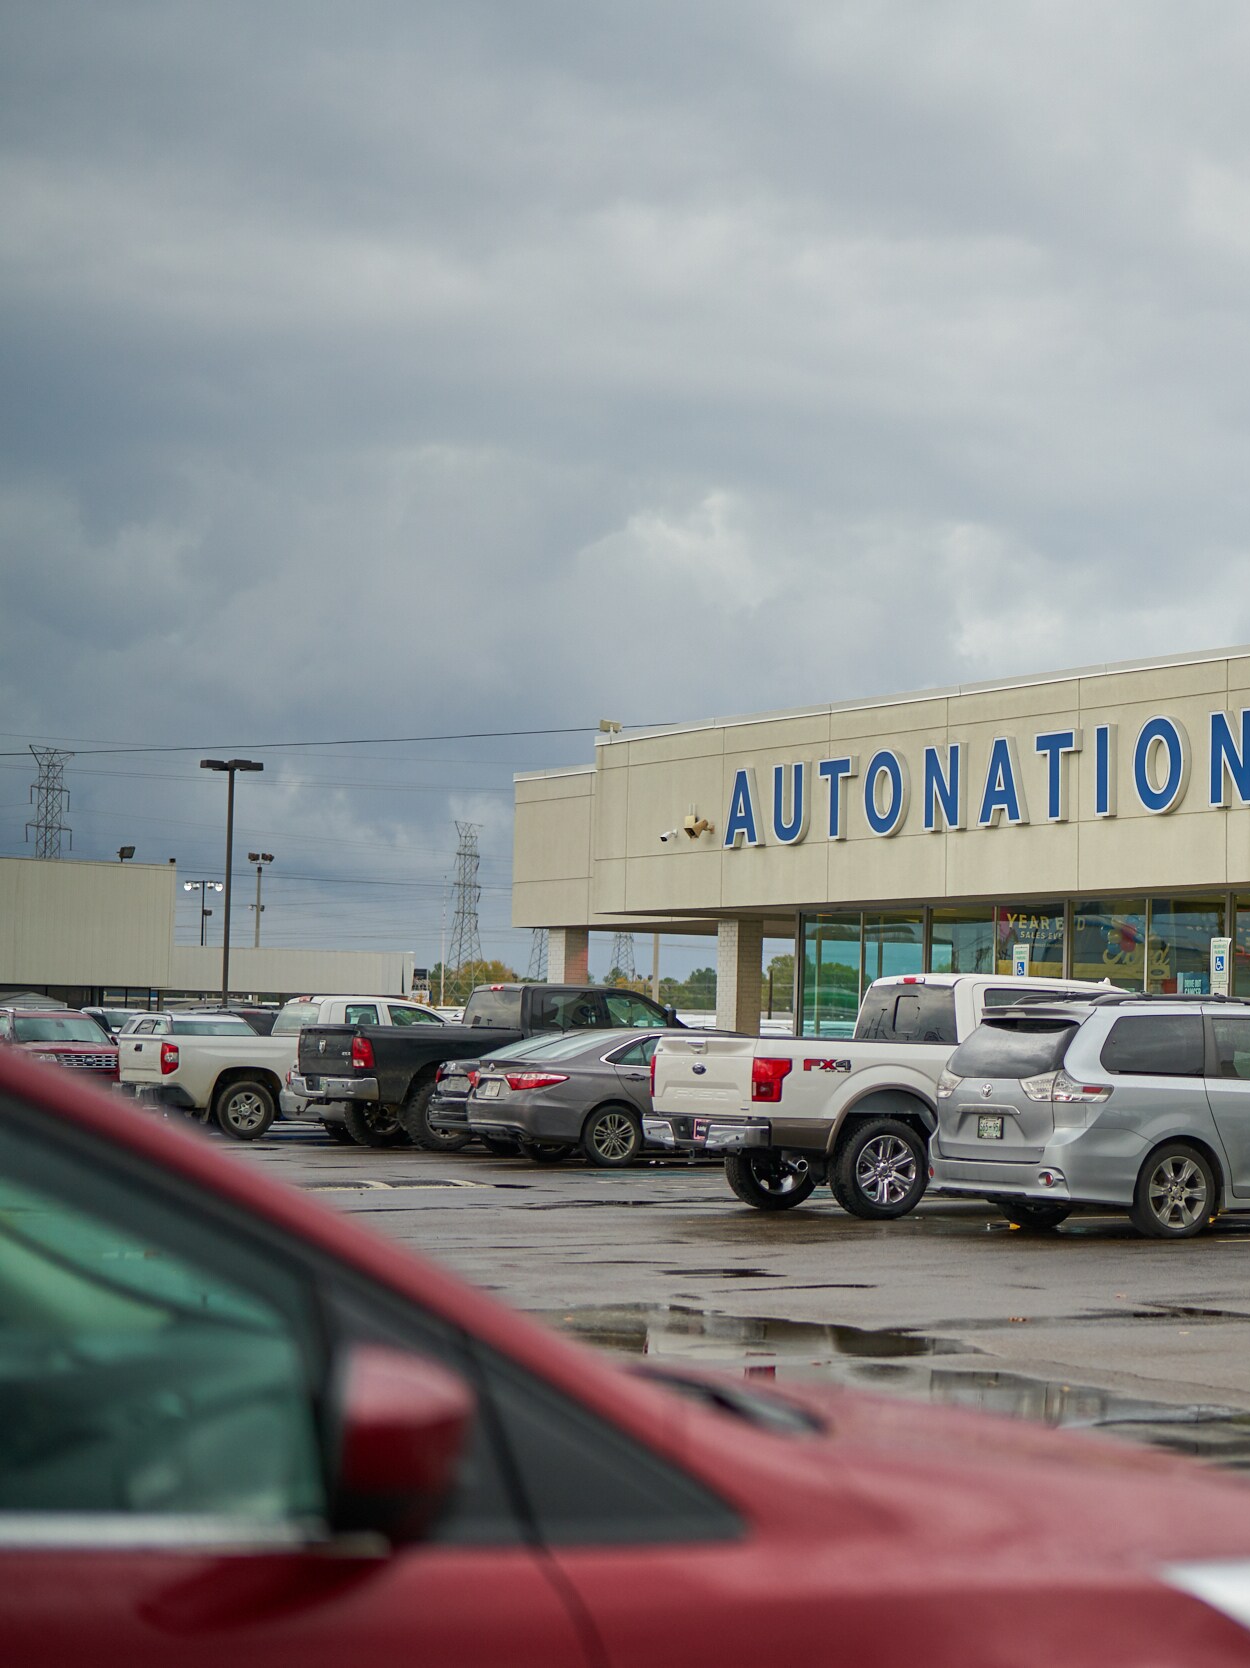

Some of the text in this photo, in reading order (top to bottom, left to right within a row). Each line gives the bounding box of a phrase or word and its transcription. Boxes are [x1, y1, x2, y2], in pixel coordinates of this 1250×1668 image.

[1007, 913, 1086, 932] YEAR ED
[1020, 930, 1046, 939] SALES
[803, 1058, 851, 1071] FX4
